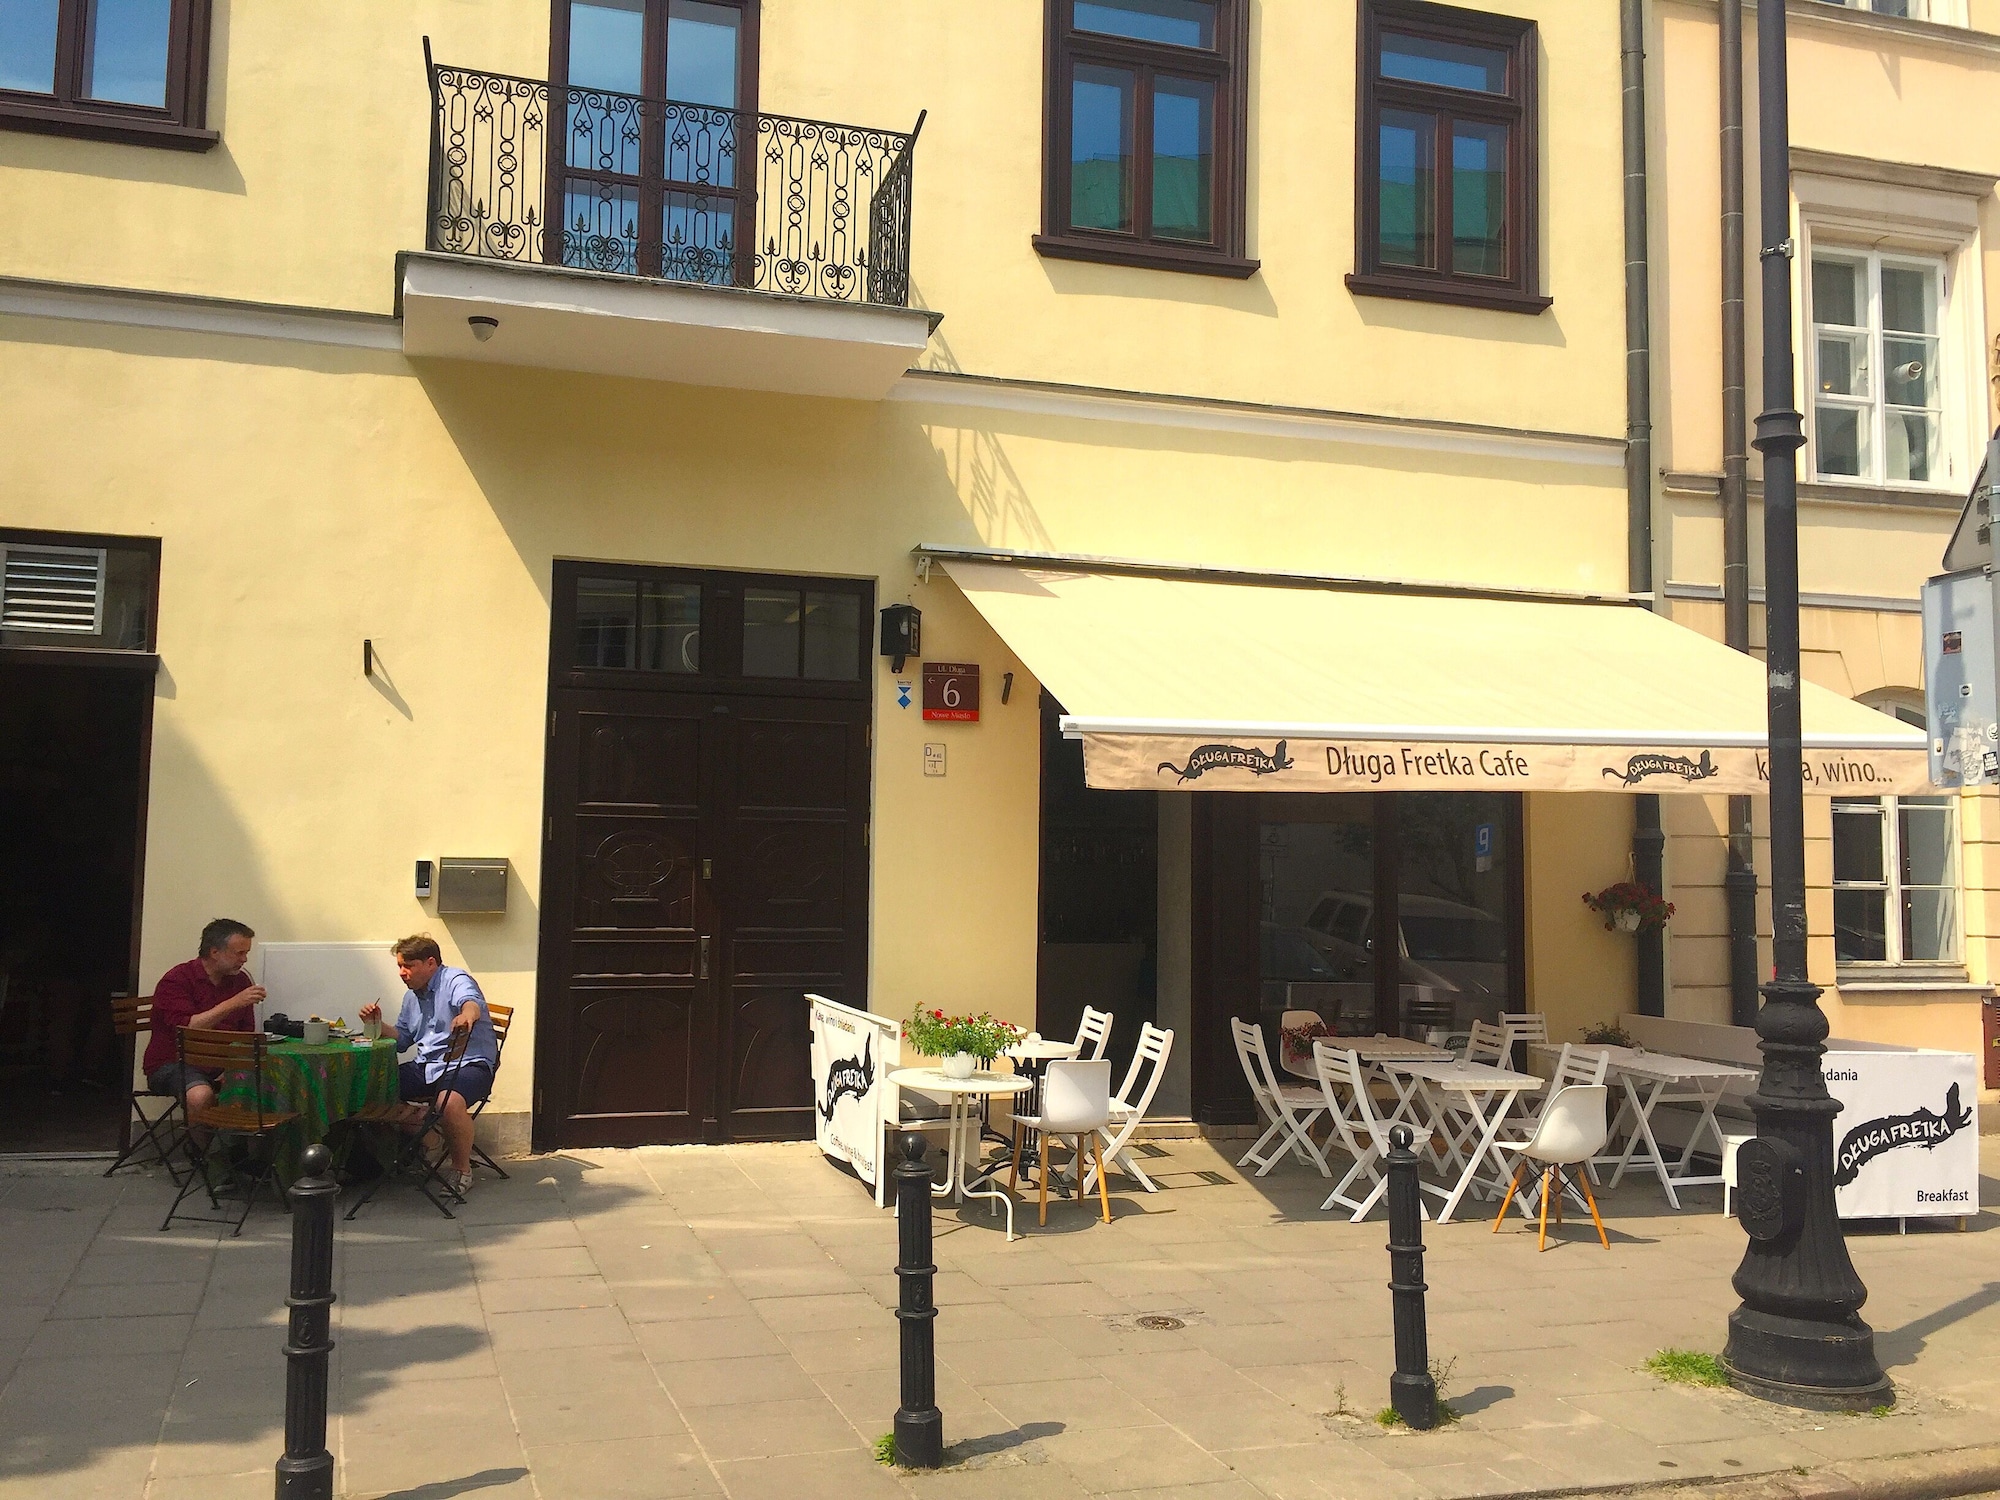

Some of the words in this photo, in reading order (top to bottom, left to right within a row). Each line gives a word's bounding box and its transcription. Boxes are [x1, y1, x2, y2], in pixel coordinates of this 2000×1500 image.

[943, 678, 961, 707] 6
[931, 711, 949, 719] Nowe
[950, 712, 971, 720] Miasto
[1191, 750, 1231, 770] DŁUGA
[1230, 752, 1277, 771] FRETKA
[1326, 746, 1396, 782] Długa
[1402, 747, 1475, 777] Fretka
[1479, 749, 1530, 776] Cafe
[1630, 757, 1662, 776] DŁUGA
[1662, 759, 1703, 777] FRETKA
[1756, 753, 1820, 786] ka,
[1823, 756, 1893, 783] wino...
[1840, 1130, 1890, 1171] DŁUGA
[1890, 1117, 1951, 1142] FRETKA
[1916, 1188, 1969, 1203] Breakfast
